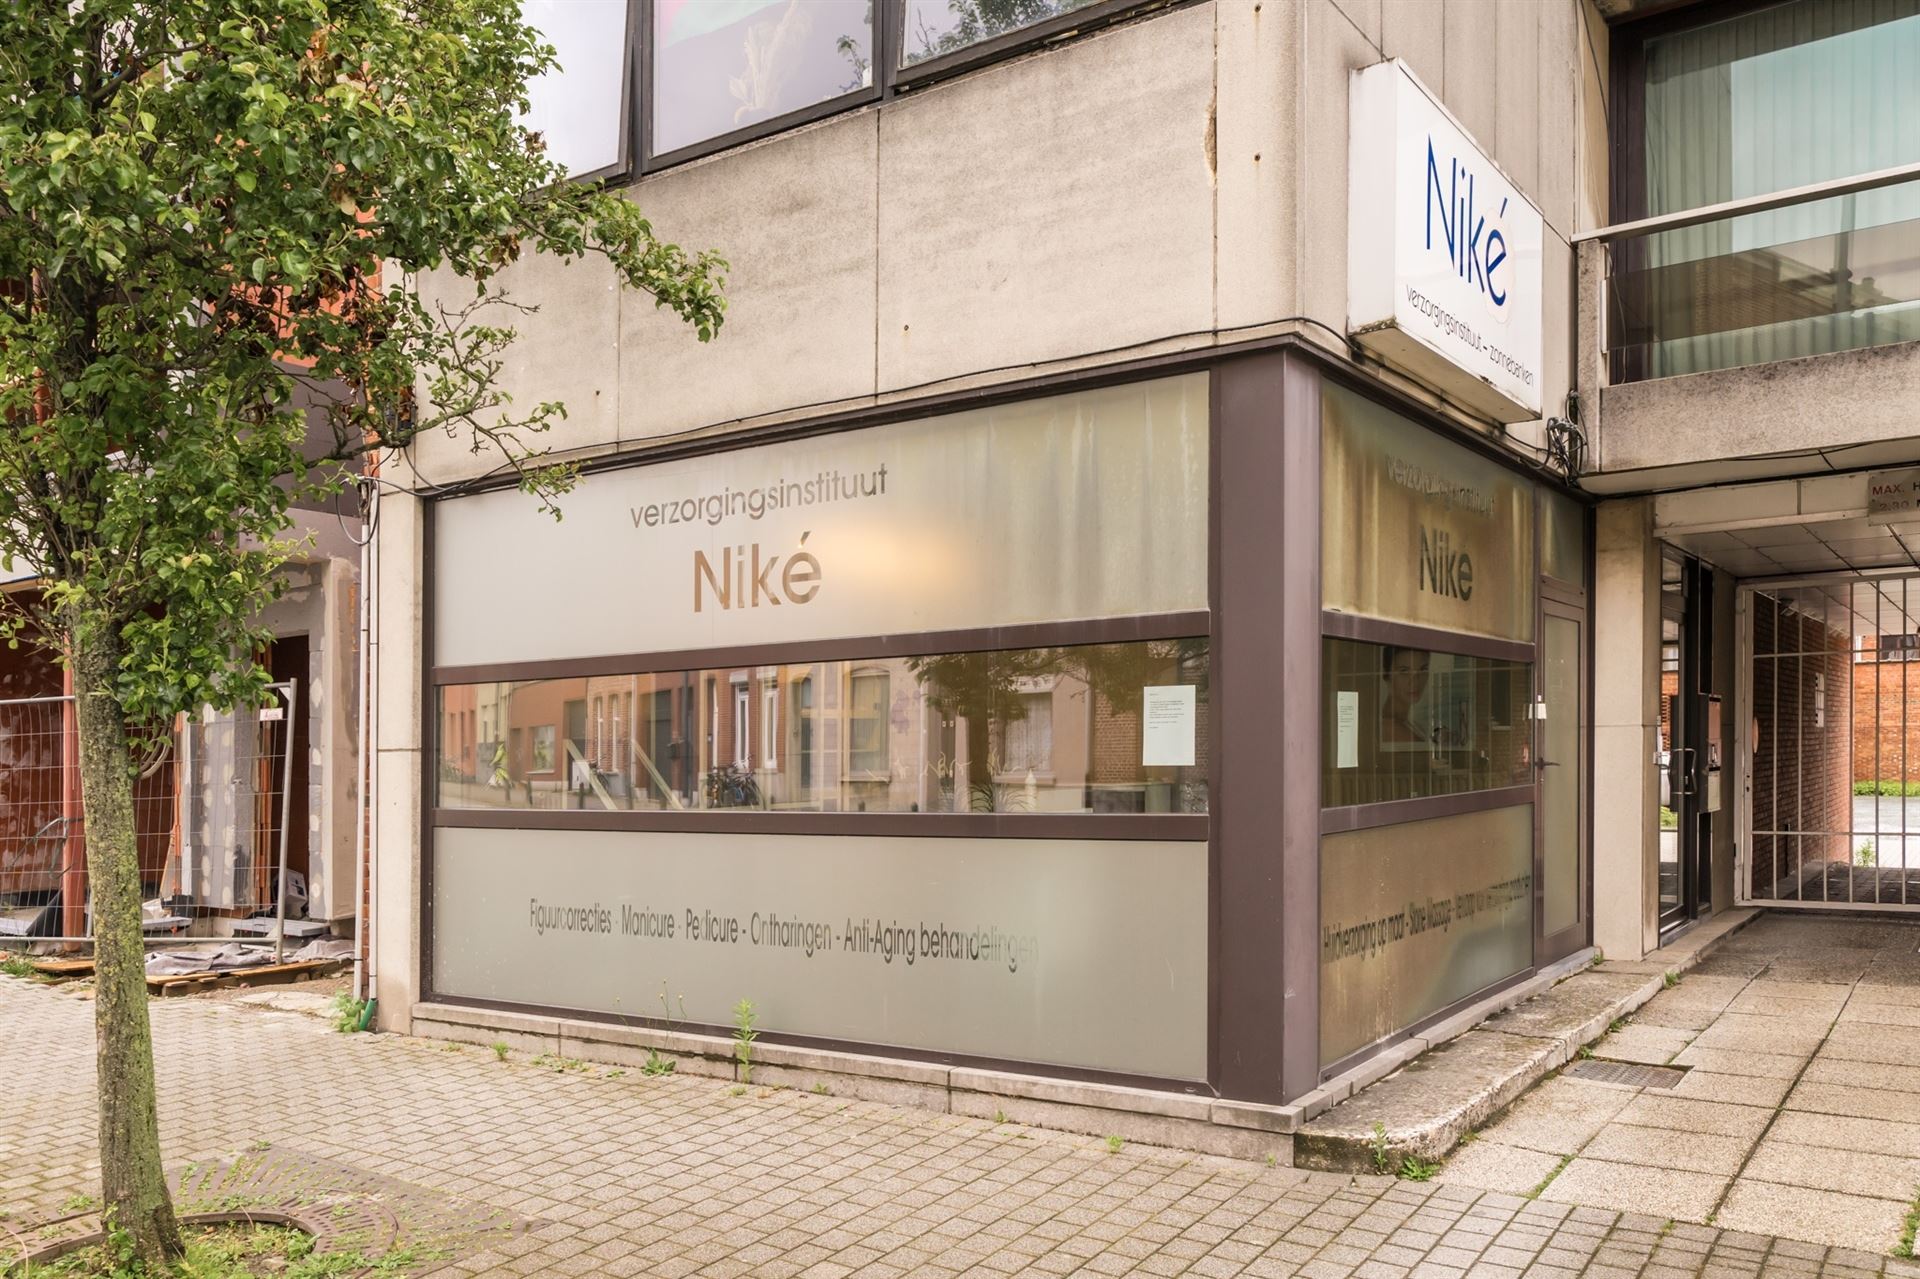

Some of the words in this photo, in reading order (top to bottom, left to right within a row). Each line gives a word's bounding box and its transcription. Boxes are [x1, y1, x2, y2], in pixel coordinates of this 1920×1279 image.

[1425, 132, 1508, 307] Niké
[1405, 283, 1482, 353] verzorgingsinstituut
[630, 463, 888, 528] verzorgingsinstituut
[1872, 483, 1905, 496] MAX.
[693, 530, 822, 613] Niké
[530, 898, 612, 936] Figuurcorrecties
[621, 904, 675, 939] Manicure
[750, 911, 833, 958] Ontharingen
[844, 917, 916, 965] Anti-Aging
[920, 921, 1040, 974] behandelingen
